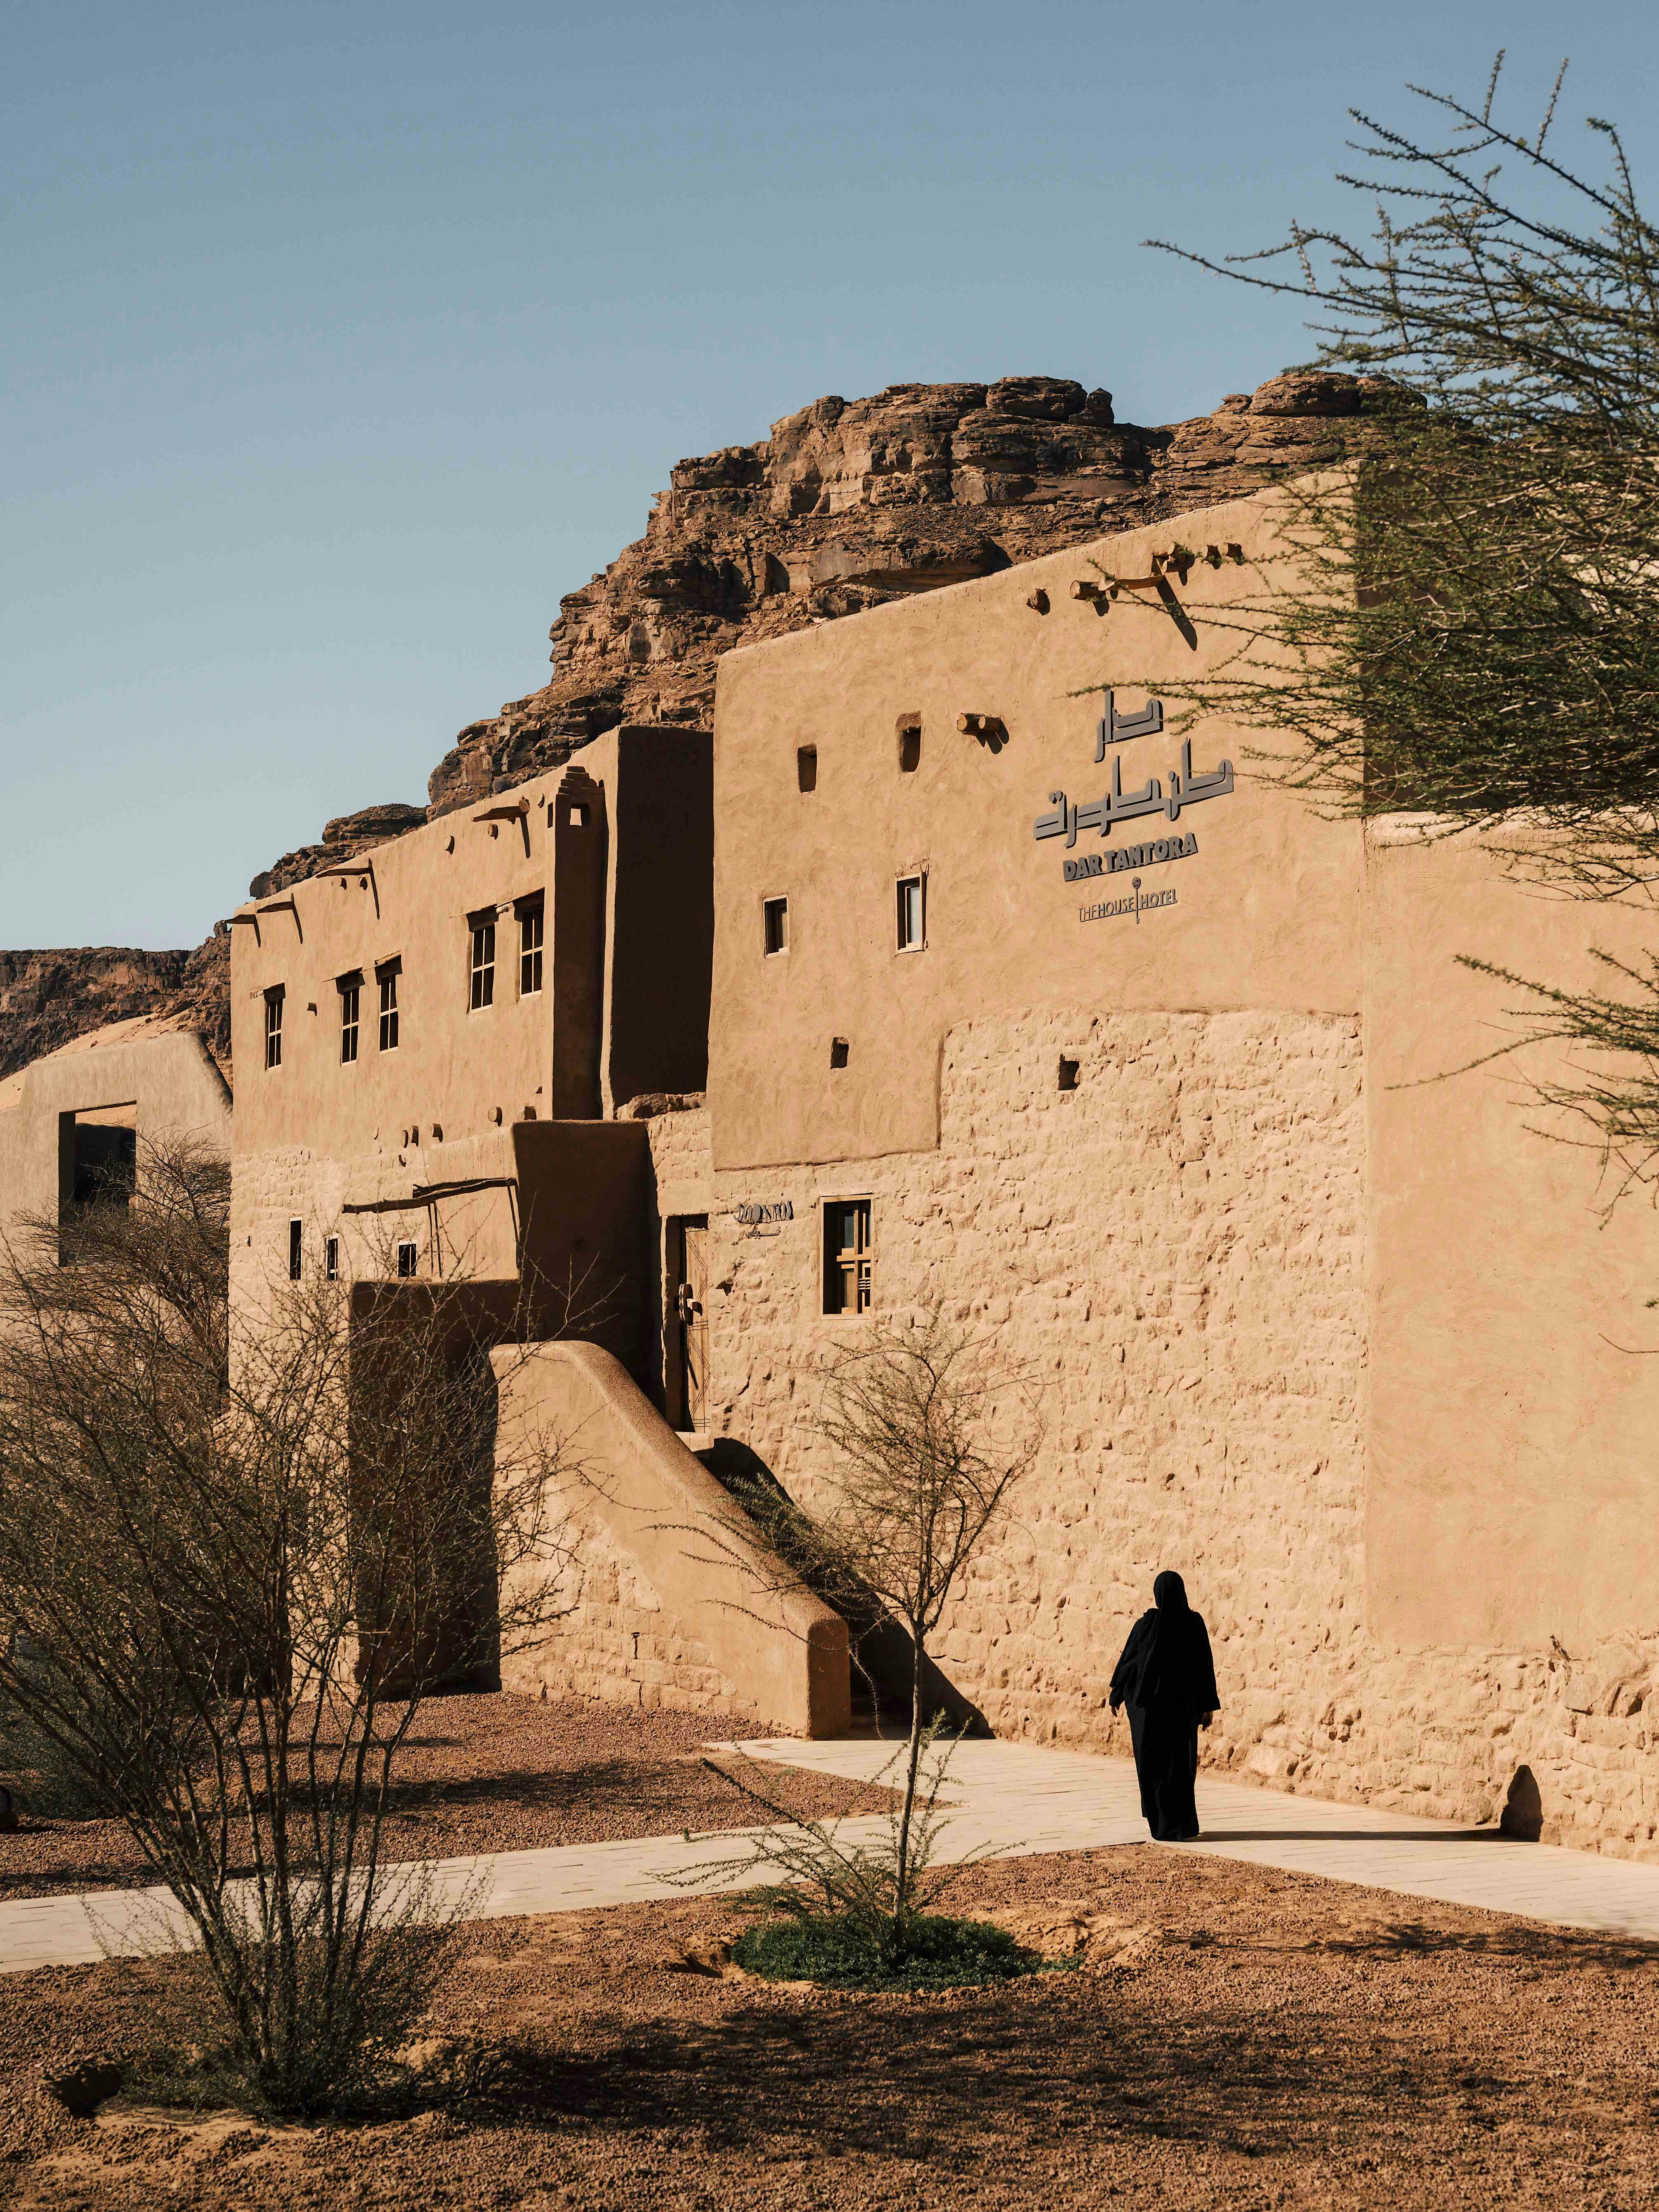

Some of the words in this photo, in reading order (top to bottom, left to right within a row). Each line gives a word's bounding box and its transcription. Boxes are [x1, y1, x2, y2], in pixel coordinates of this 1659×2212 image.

[1095, 689, 1163, 763] دار
[1033, 736, 1234, 849] طنطورة
[1063, 854, 1102, 881] DAR
[1103, 832, 1198, 872] TANTORA
[1097, 897, 1135, 919] HOUSE
[1140, 889, 1178, 910] HOTEL
